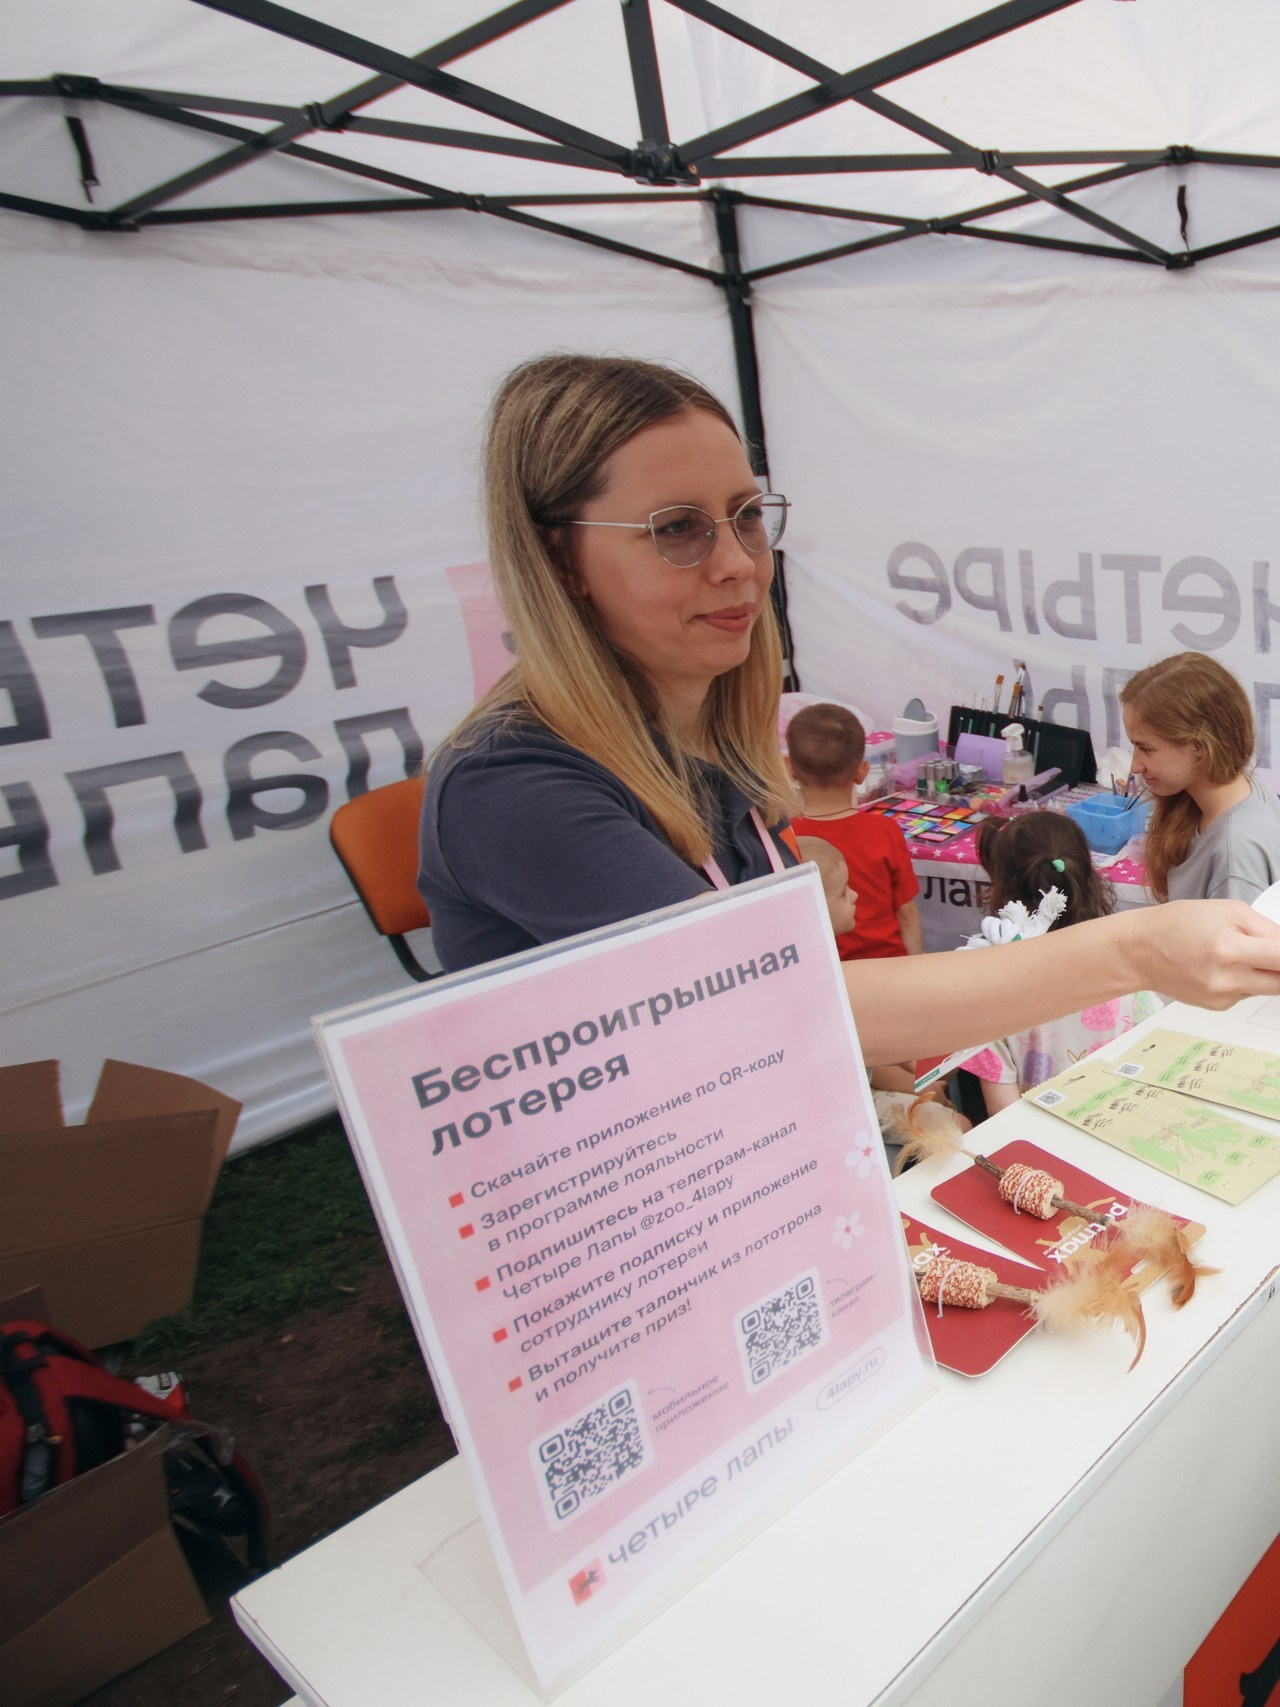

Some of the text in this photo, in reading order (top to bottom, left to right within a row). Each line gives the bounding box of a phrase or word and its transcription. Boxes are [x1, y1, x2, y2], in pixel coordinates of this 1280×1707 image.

[411, 943, 801, 1109] Беспроигрышная
[431, 1053, 631, 1156] лотерея
[470, 1049, 785, 1199] Скачайте приложение по QR-коду
[480, 1130, 677, 1230] Зарегистрируйтесь
[487, 1128, 725, 1253] в программе лояльности
[496, 1120, 798, 1281] Подпишитесь на телеграм-канал
[502, 1174, 735, 1301] Четыре Лапы @zoo_4lapy
[513, 1159, 818, 1333] Покажите подписку и приложение
[520, 1239, 709, 1353] сотруднику лотереи
[527, 1204, 822, 1382] Вытащите талончик из лототрона
[534, 1299, 692, 1403] и получите приз!
[830, 1295, 860, 1319] канал
[652, 1375, 719, 1421] мобильное
[654, 1381, 730, 1434] приложение
[825, 1356, 878, 1401] 4lapy.ru
[607, 1417, 794, 1565] четыре лапы
